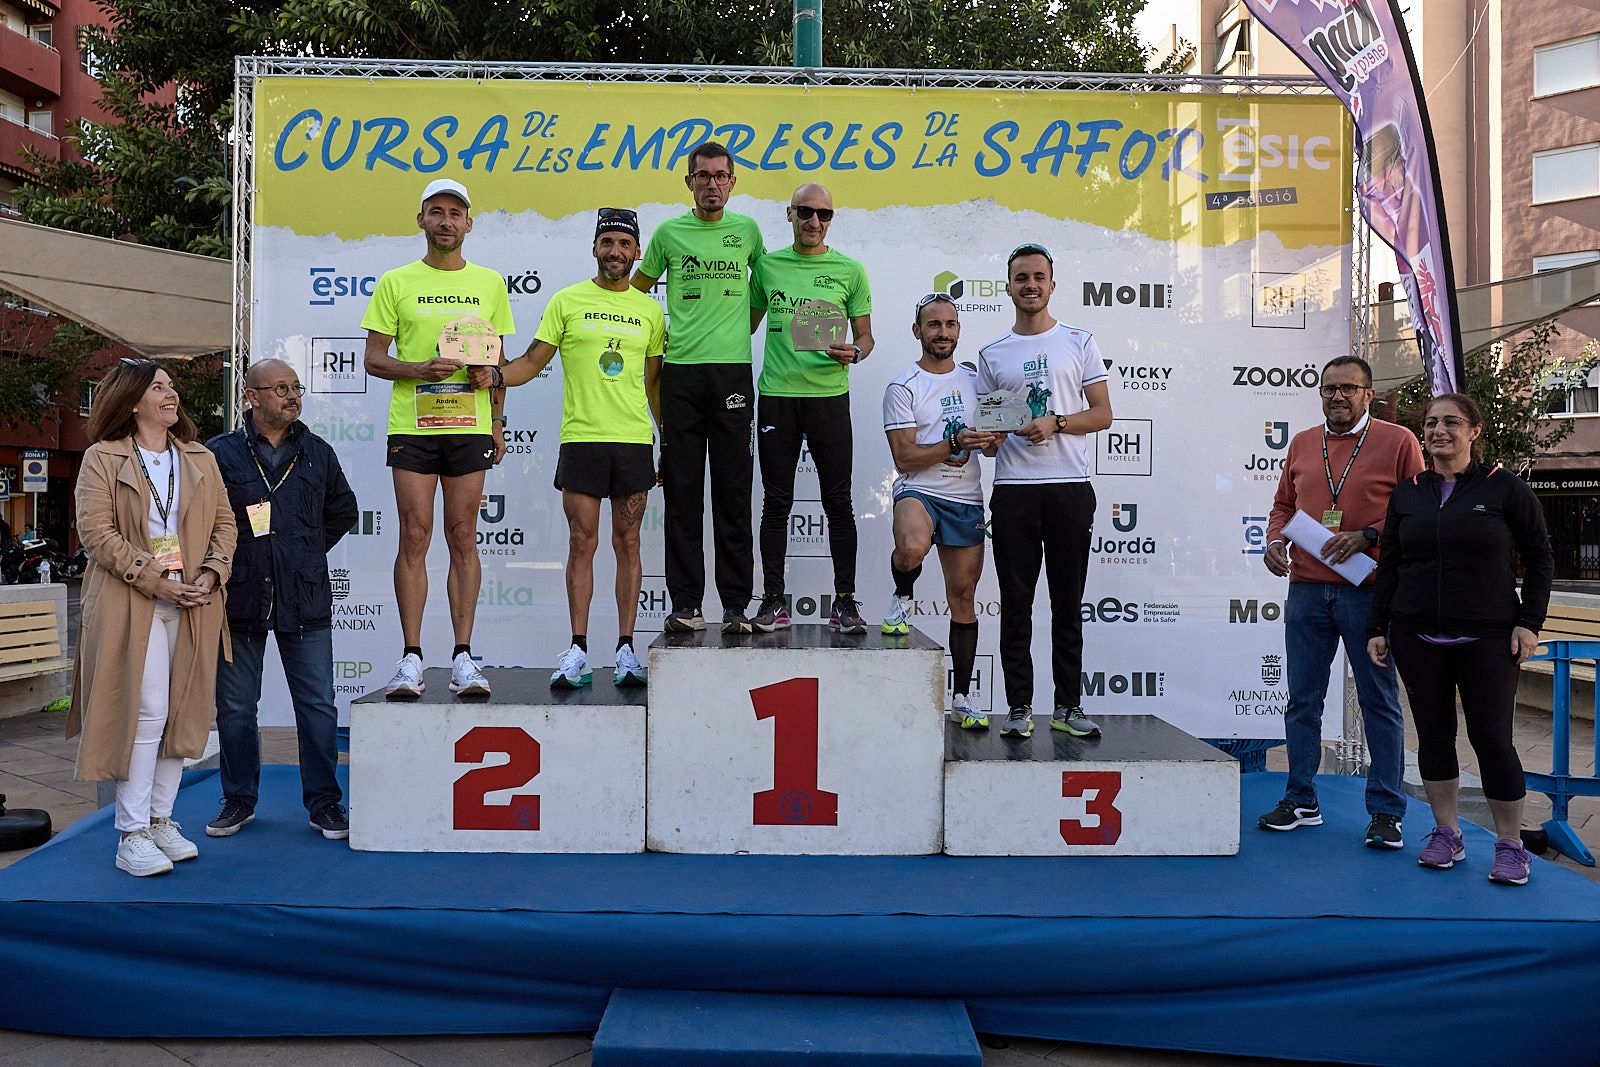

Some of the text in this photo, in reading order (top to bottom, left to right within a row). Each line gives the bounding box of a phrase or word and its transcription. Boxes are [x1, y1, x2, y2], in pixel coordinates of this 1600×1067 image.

[274, 108, 1209, 183] CURSA DE LES EMPRESES DE LA SAFOR
[1220, 127, 1331, 174] esic
[1236, 190, 1292, 205] edició
[703, 260, 742, 272] VIDAL
[682, 272, 741, 281] CONSTRUCCIONES
[311, 273, 376, 300] esic
[966, 280, 1007, 297] TBP
[418, 295, 480, 306] RECICLAR
[1083, 282, 1164, 308] Moll
[955, 304, 1002, 313] BLEPRINT
[584, 312, 642, 327] RECICLAR
[323, 351, 356, 373] RH
[1118, 366, 1173, 380] VICKY
[1232, 363, 1320, 388] ZOOKÖ
[1123, 381, 1167, 391] FOODS
[310, 416, 374, 441] eika
[503, 430, 538, 443] CKY
[506, 446, 532, 454] ODS
[1107, 433, 1141, 455] RH
[1244, 454, 1287, 471] Jor
[1562, 480, 1600, 488] COMIDA
[790, 514, 824, 536] RH
[476, 548, 516, 556] RONCES
[1100, 557, 1148, 565] BRONCES
[331, 604, 383, 616] TAMENT
[1080, 597, 1139, 623] aes
[1081, 672, 1157, 697] Moll
[1228, 690, 1290, 702] AJUNTAM
[1235, 704, 1288, 715] DE GAN
[749, 677, 838, 827] 1
[453, 726, 541, 831] 2
[1059, 771, 1122, 845] 3
